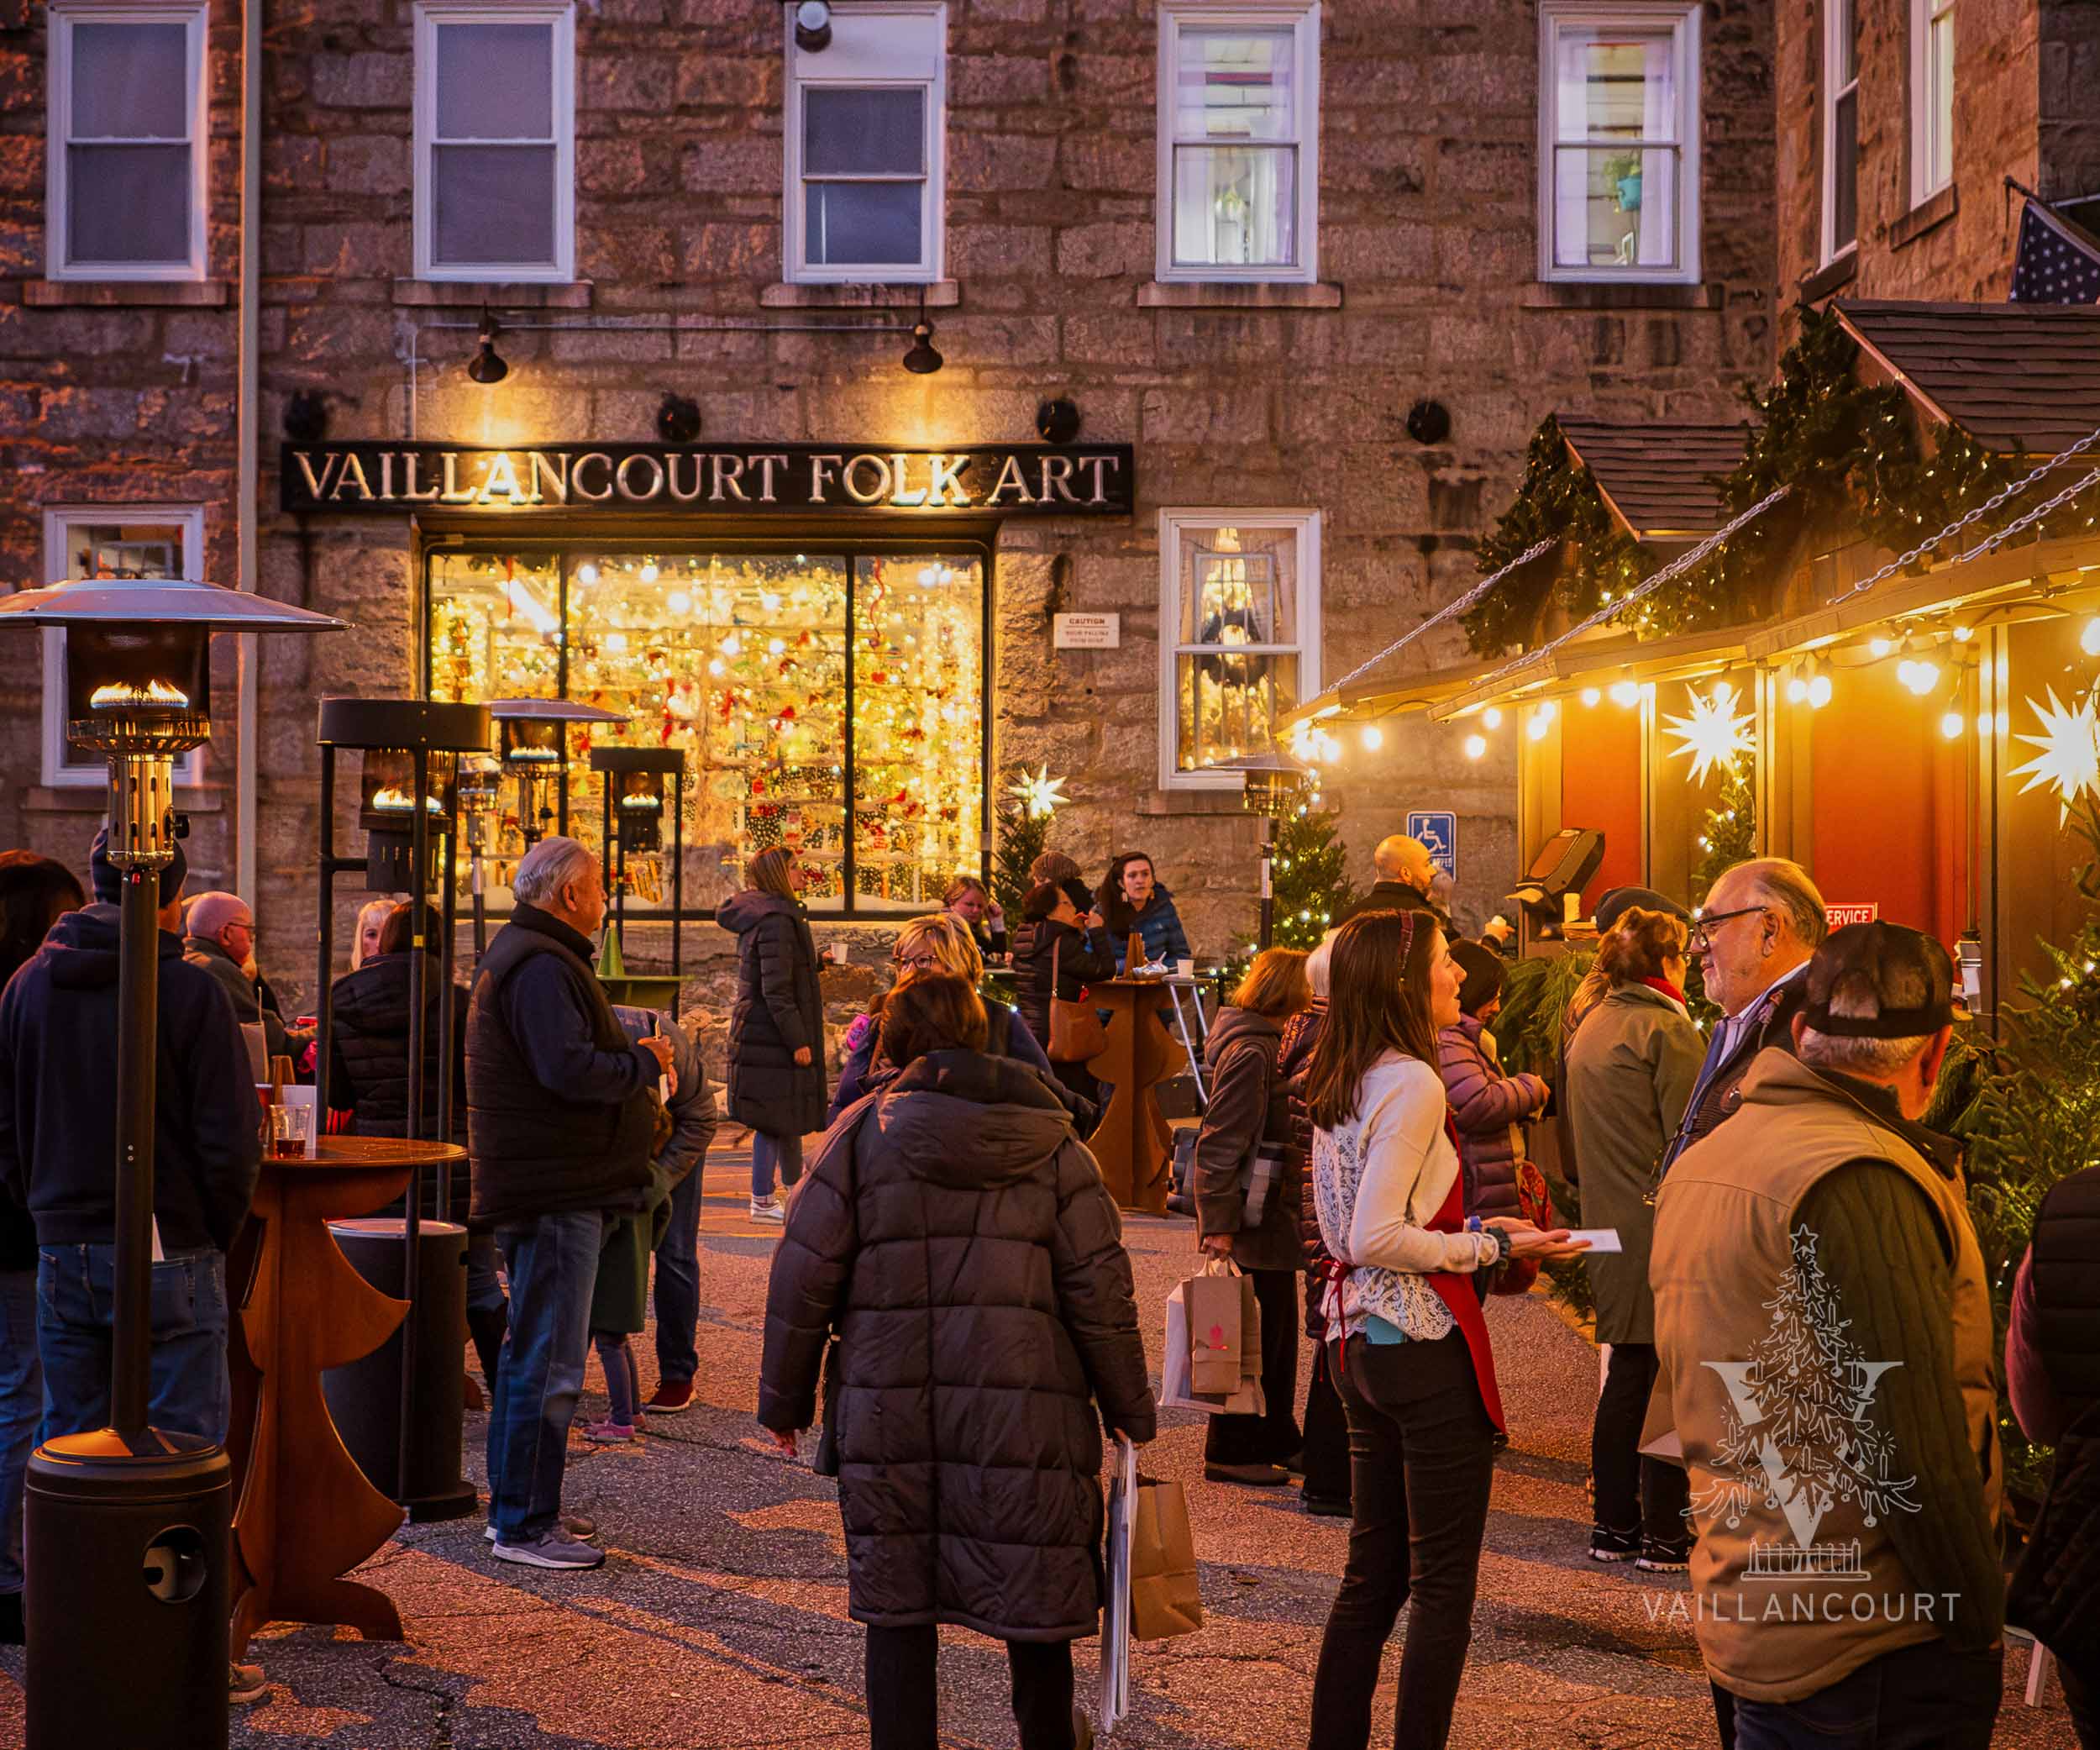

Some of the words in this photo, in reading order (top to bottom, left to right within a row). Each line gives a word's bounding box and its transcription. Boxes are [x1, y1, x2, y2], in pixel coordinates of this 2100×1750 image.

[291, 450, 788, 506] VAILLANCOURT
[807, 451, 972, 506] FOLK
[985, 454, 1119, 504] ART
[1825, 908, 1869, 926] ERVICE
